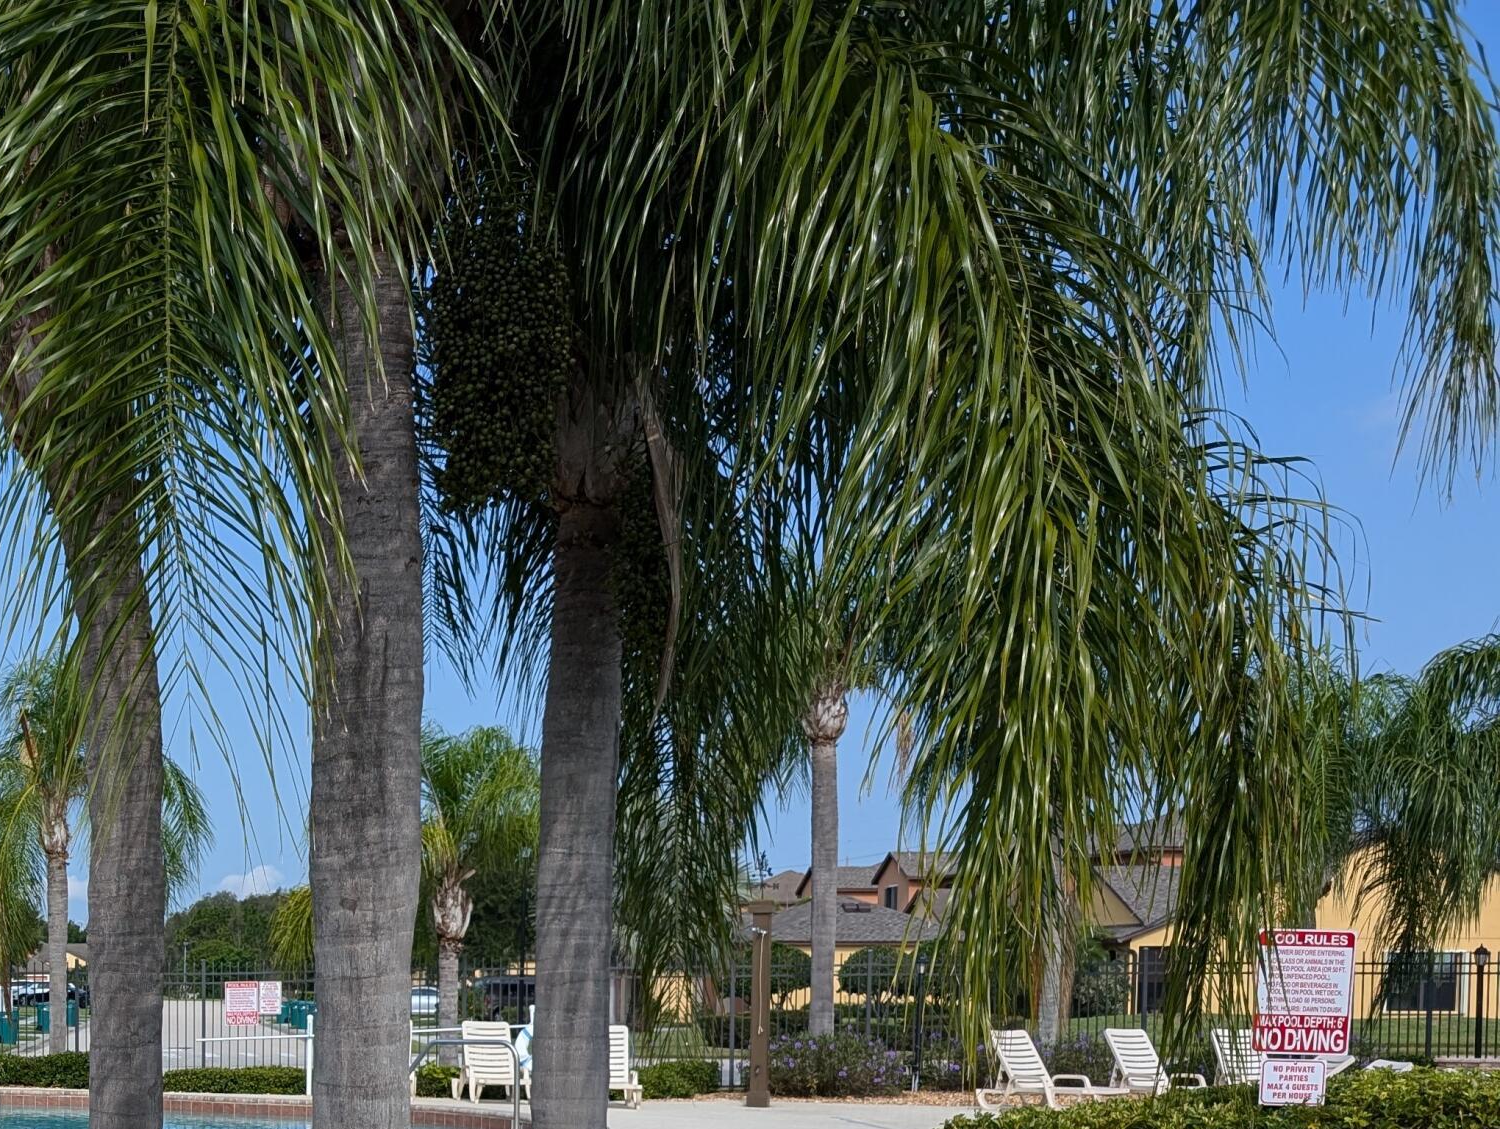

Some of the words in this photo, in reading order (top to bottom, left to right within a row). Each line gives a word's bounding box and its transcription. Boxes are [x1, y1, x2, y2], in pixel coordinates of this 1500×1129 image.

[1272, 933, 1303, 945] OOL
[1304, 934, 1349, 946] RULES
[1257, 1015, 1277, 1027] MAX
[1278, 1016, 1303, 1028] POOL
[1304, 1017, 1336, 1029] DEPTH:
[1337, 1018, 1345, 1029] 6'
[1255, 1028, 1282, 1051] NO
[1284, 1028, 1344, 1052] DIVING
[1273, 1065, 1283, 1073] NO
[1289, 1092, 1312, 1100] HOUSE
